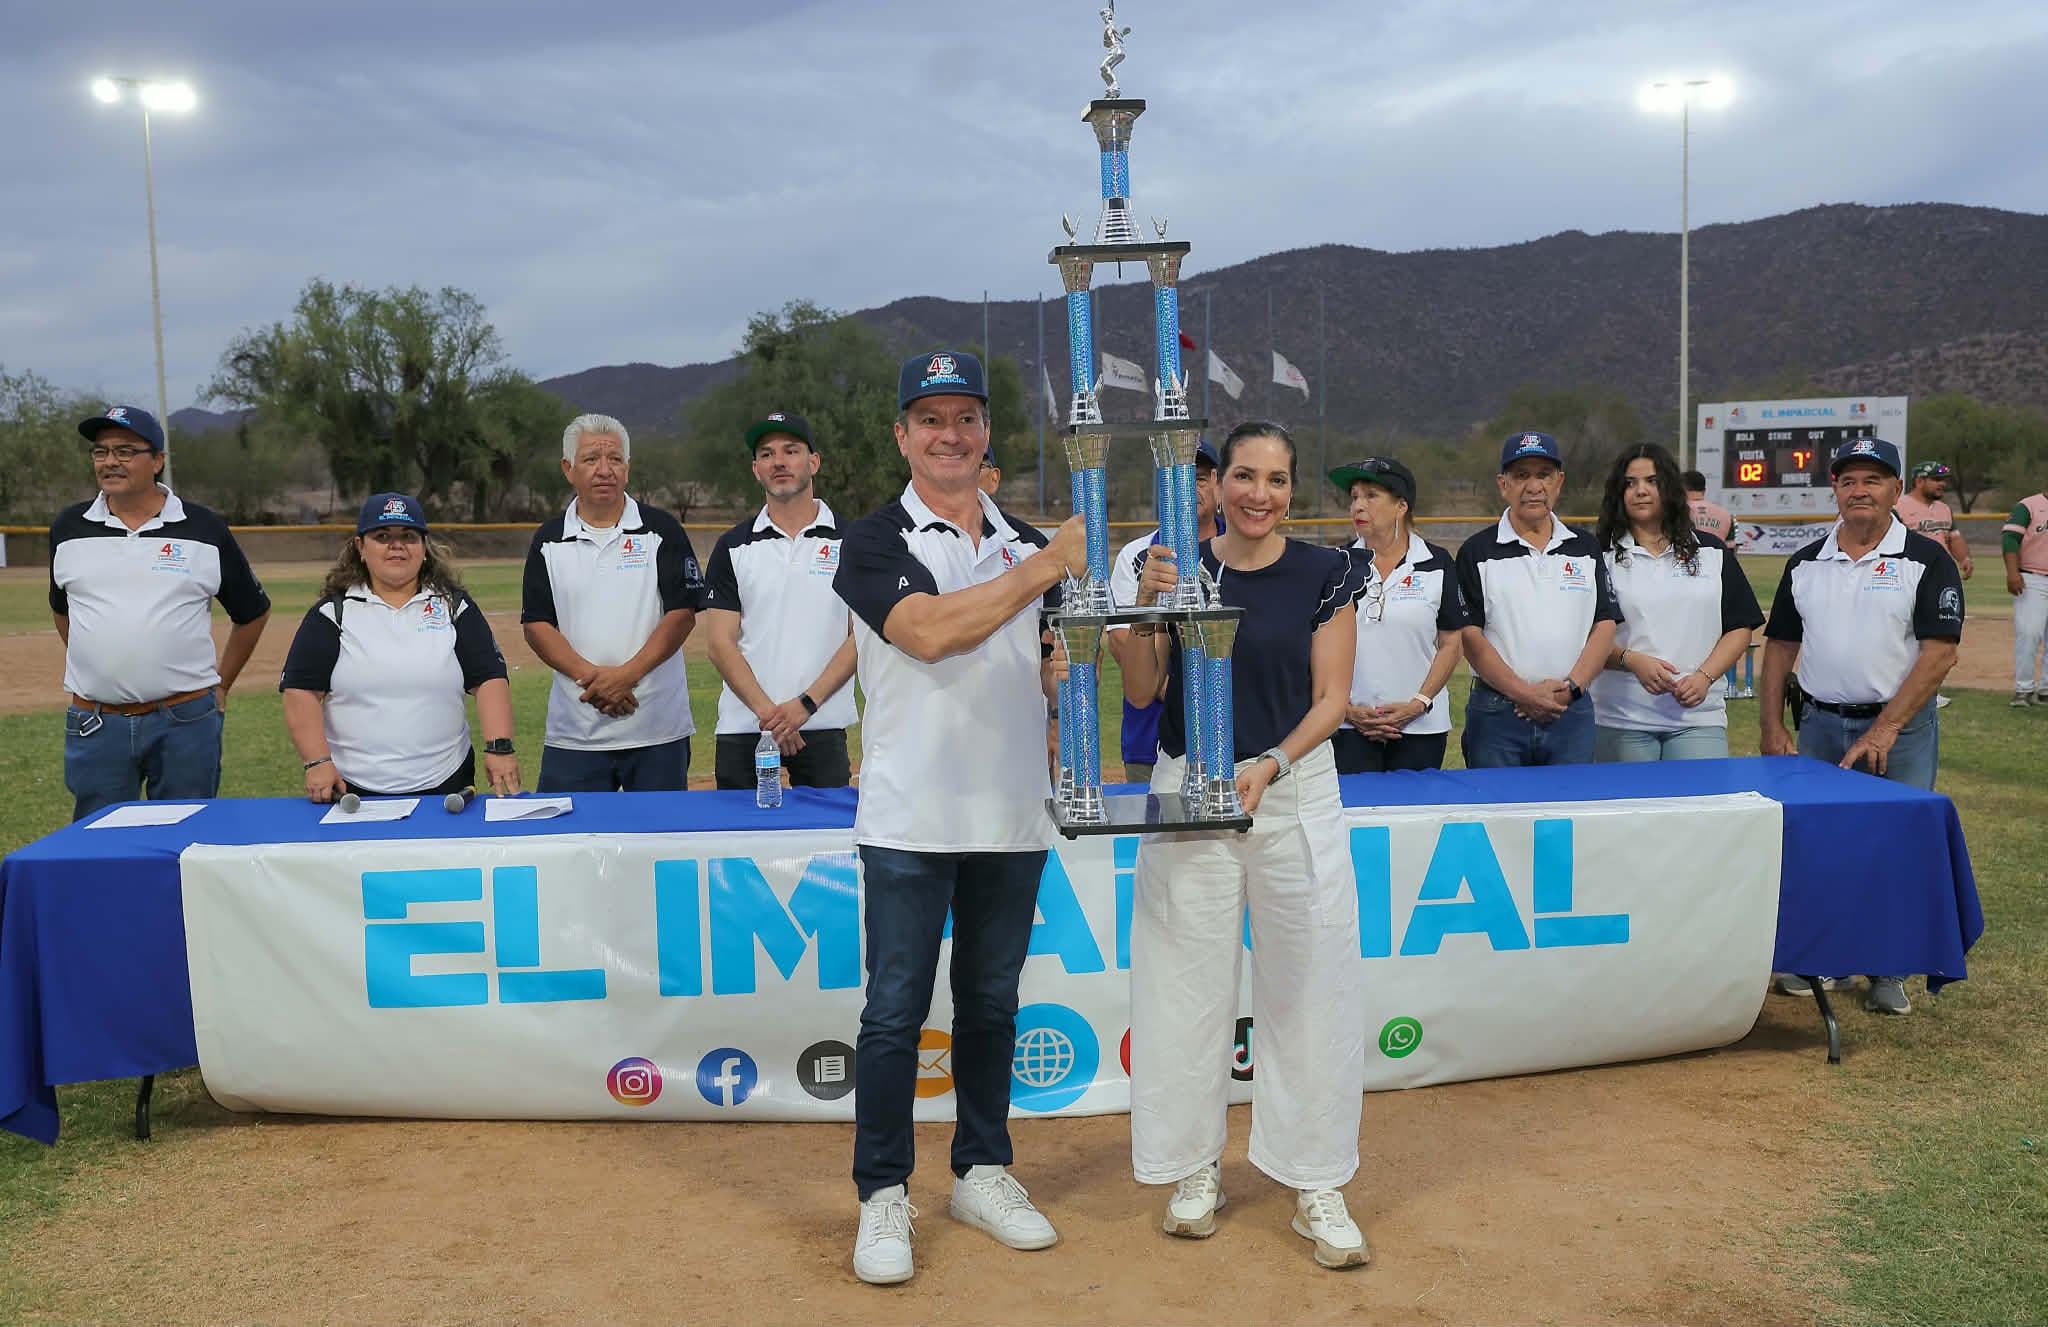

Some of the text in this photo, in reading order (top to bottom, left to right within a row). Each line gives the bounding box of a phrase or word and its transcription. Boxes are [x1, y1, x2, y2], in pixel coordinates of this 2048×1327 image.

[927, 356, 955, 377] 45
[1740, 463, 1763, 482] 02
[160, 543, 183, 557] 45
[623, 537, 643, 552] 45
[819, 544, 840, 560] 45
[1002, 547, 1021, 567] 45
[1564, 561, 1582, 576] 45
[1874, 560, 1897, 576] 45
[1400, 575, 1422, 587] 45
[423, 600, 442, 615] 45
[361, 865, 606, 1009] EL
